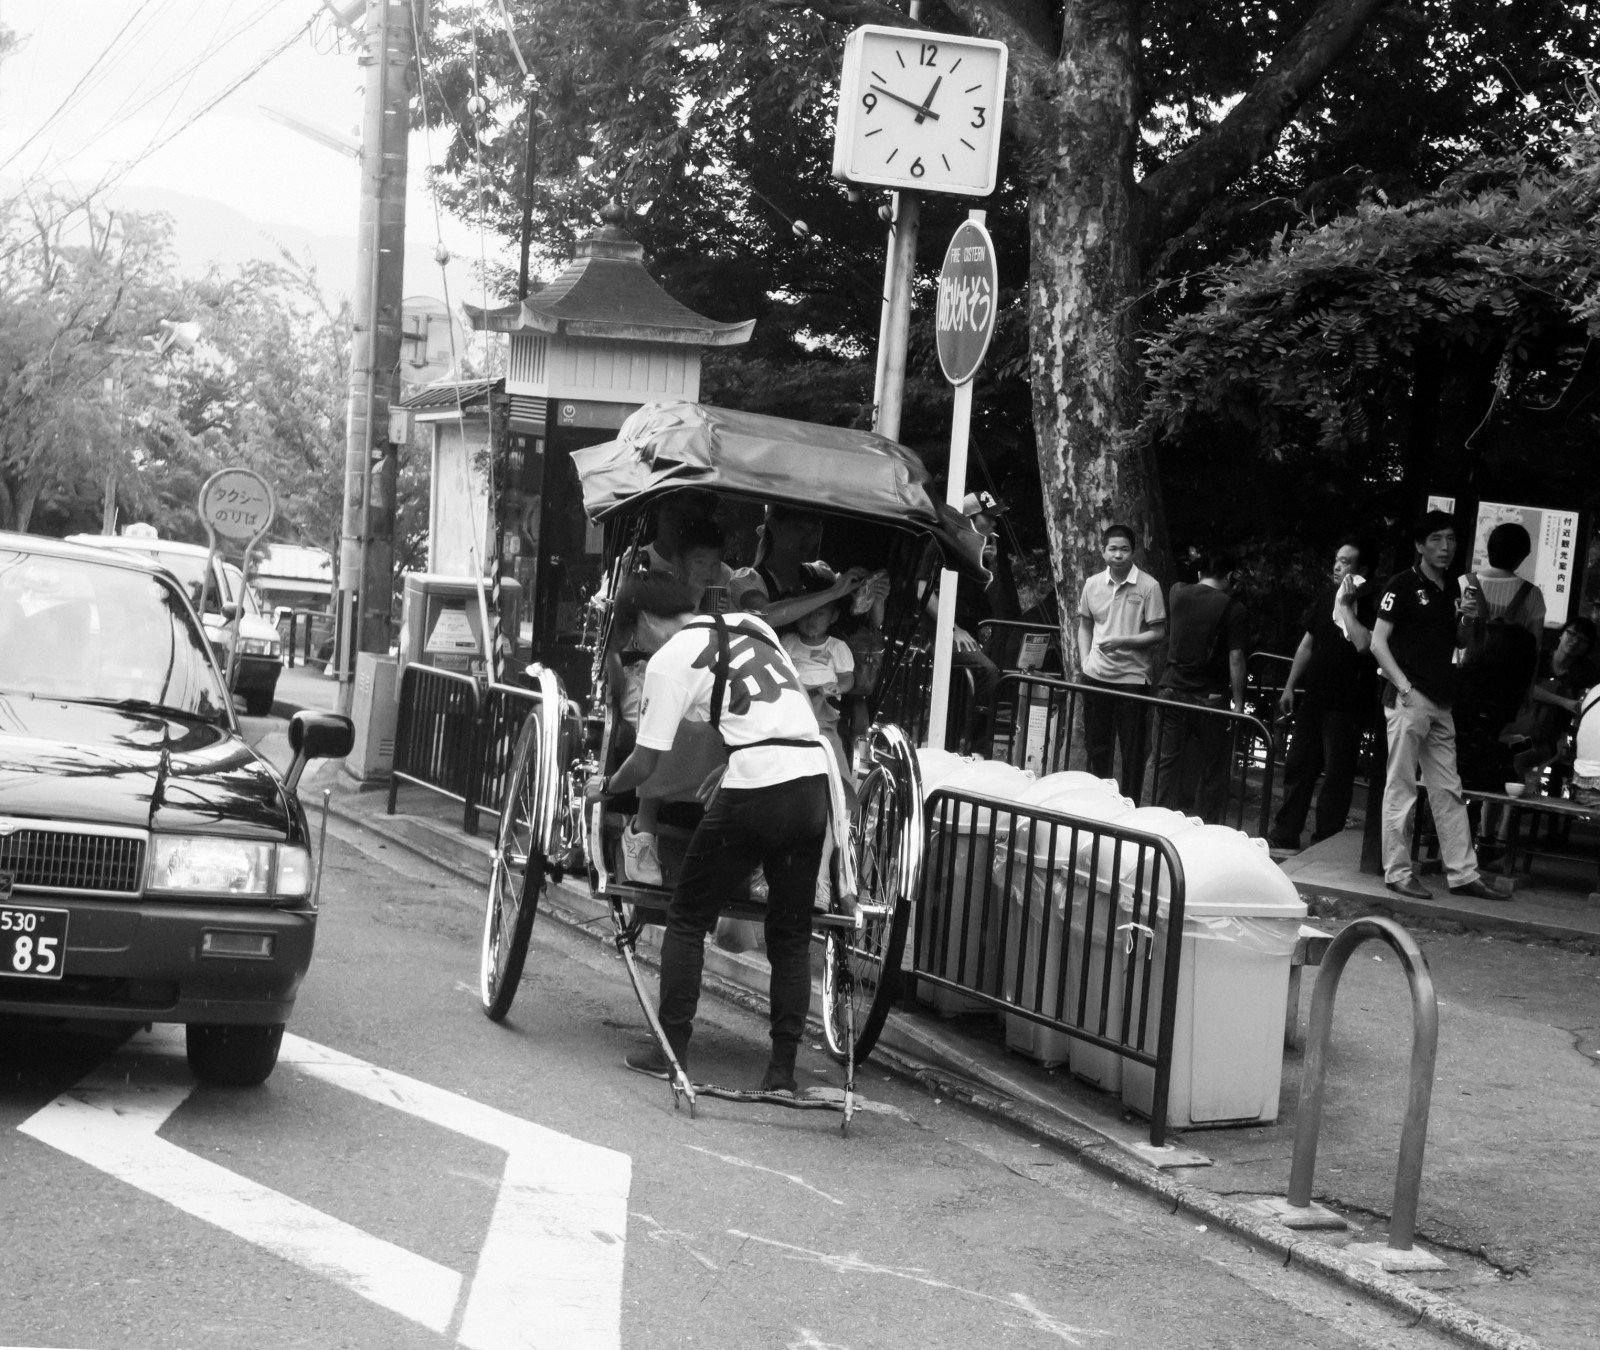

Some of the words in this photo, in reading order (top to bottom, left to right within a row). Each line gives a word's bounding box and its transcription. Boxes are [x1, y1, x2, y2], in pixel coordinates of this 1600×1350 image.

[920, 43, 938, 67] 12
[862, 92, 878, 115] 9
[970, 106, 986, 129] 3
[910, 156, 925, 178] 6
[950, 247, 961, 263] FIRE
[963, 245, 986, 263] CISTERN
[215, 487, 263, 505] タクシー
[215, 510, 258, 525] のりば
[1556, 517, 1572, 594] 付近観光案内図
[1380, 591, 1396, 612] 45
[0, 911, 37, 932] 530
[13, 935, 58, 973] 85
